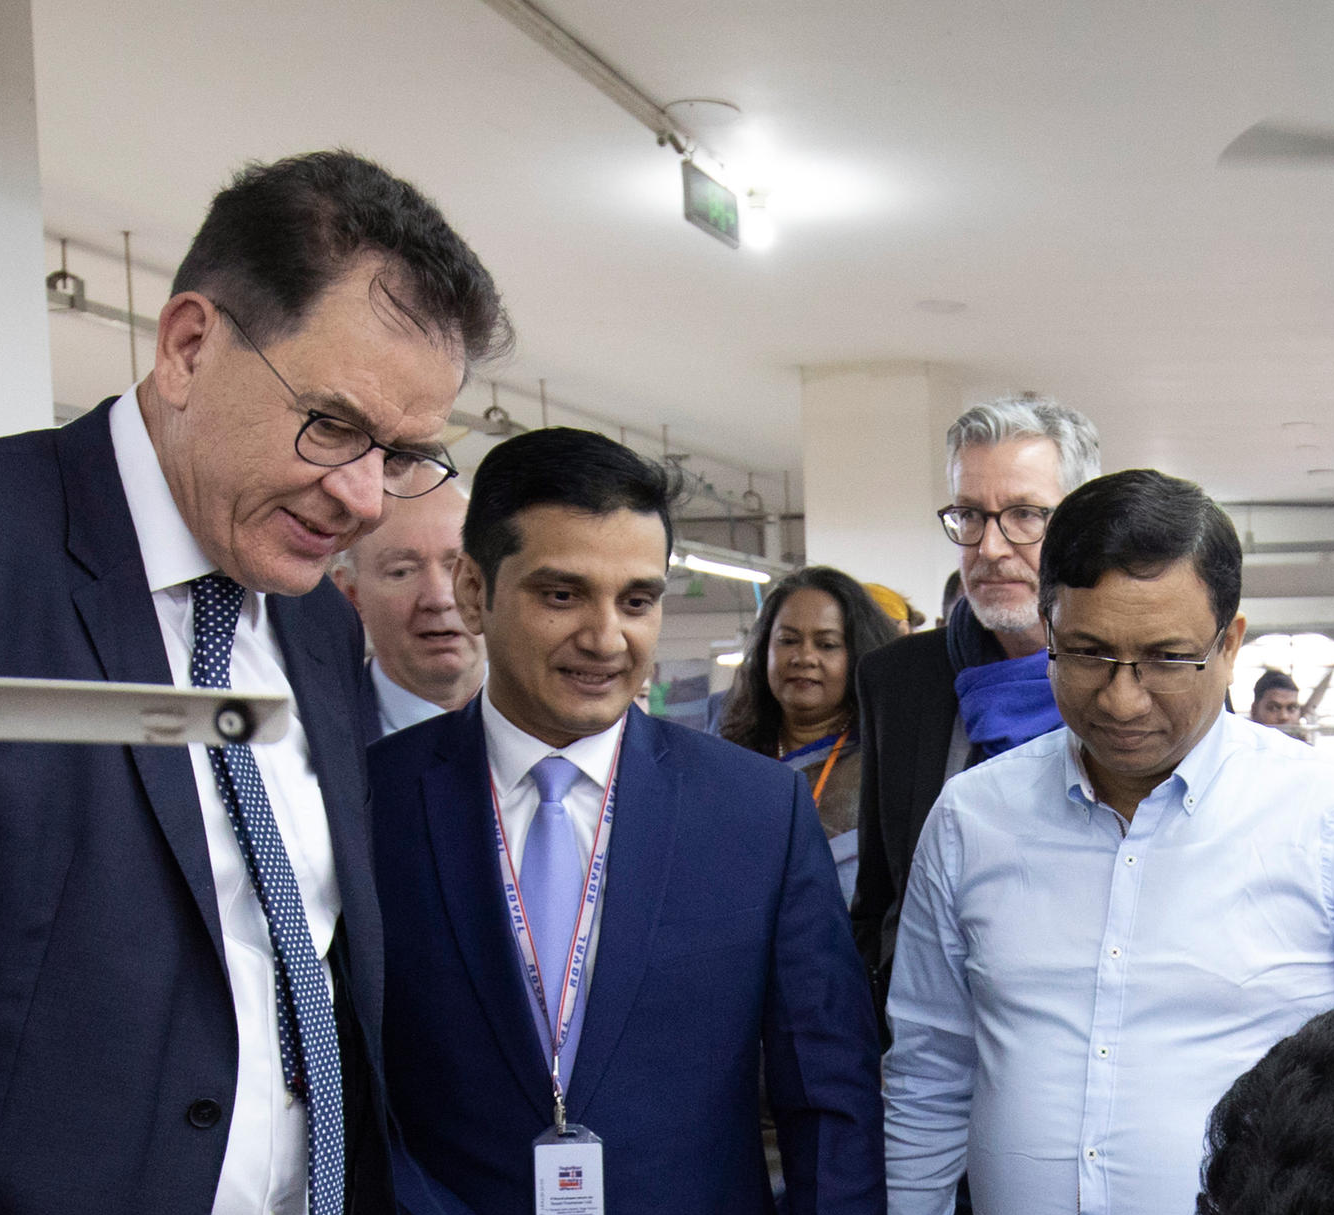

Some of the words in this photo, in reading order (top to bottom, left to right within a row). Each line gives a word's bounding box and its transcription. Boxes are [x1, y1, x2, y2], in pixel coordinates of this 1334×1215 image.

[586, 852, 605, 904] ROYAL
[505, 882, 526, 935] ROYAL
[569, 935, 587, 988] ROYAL
